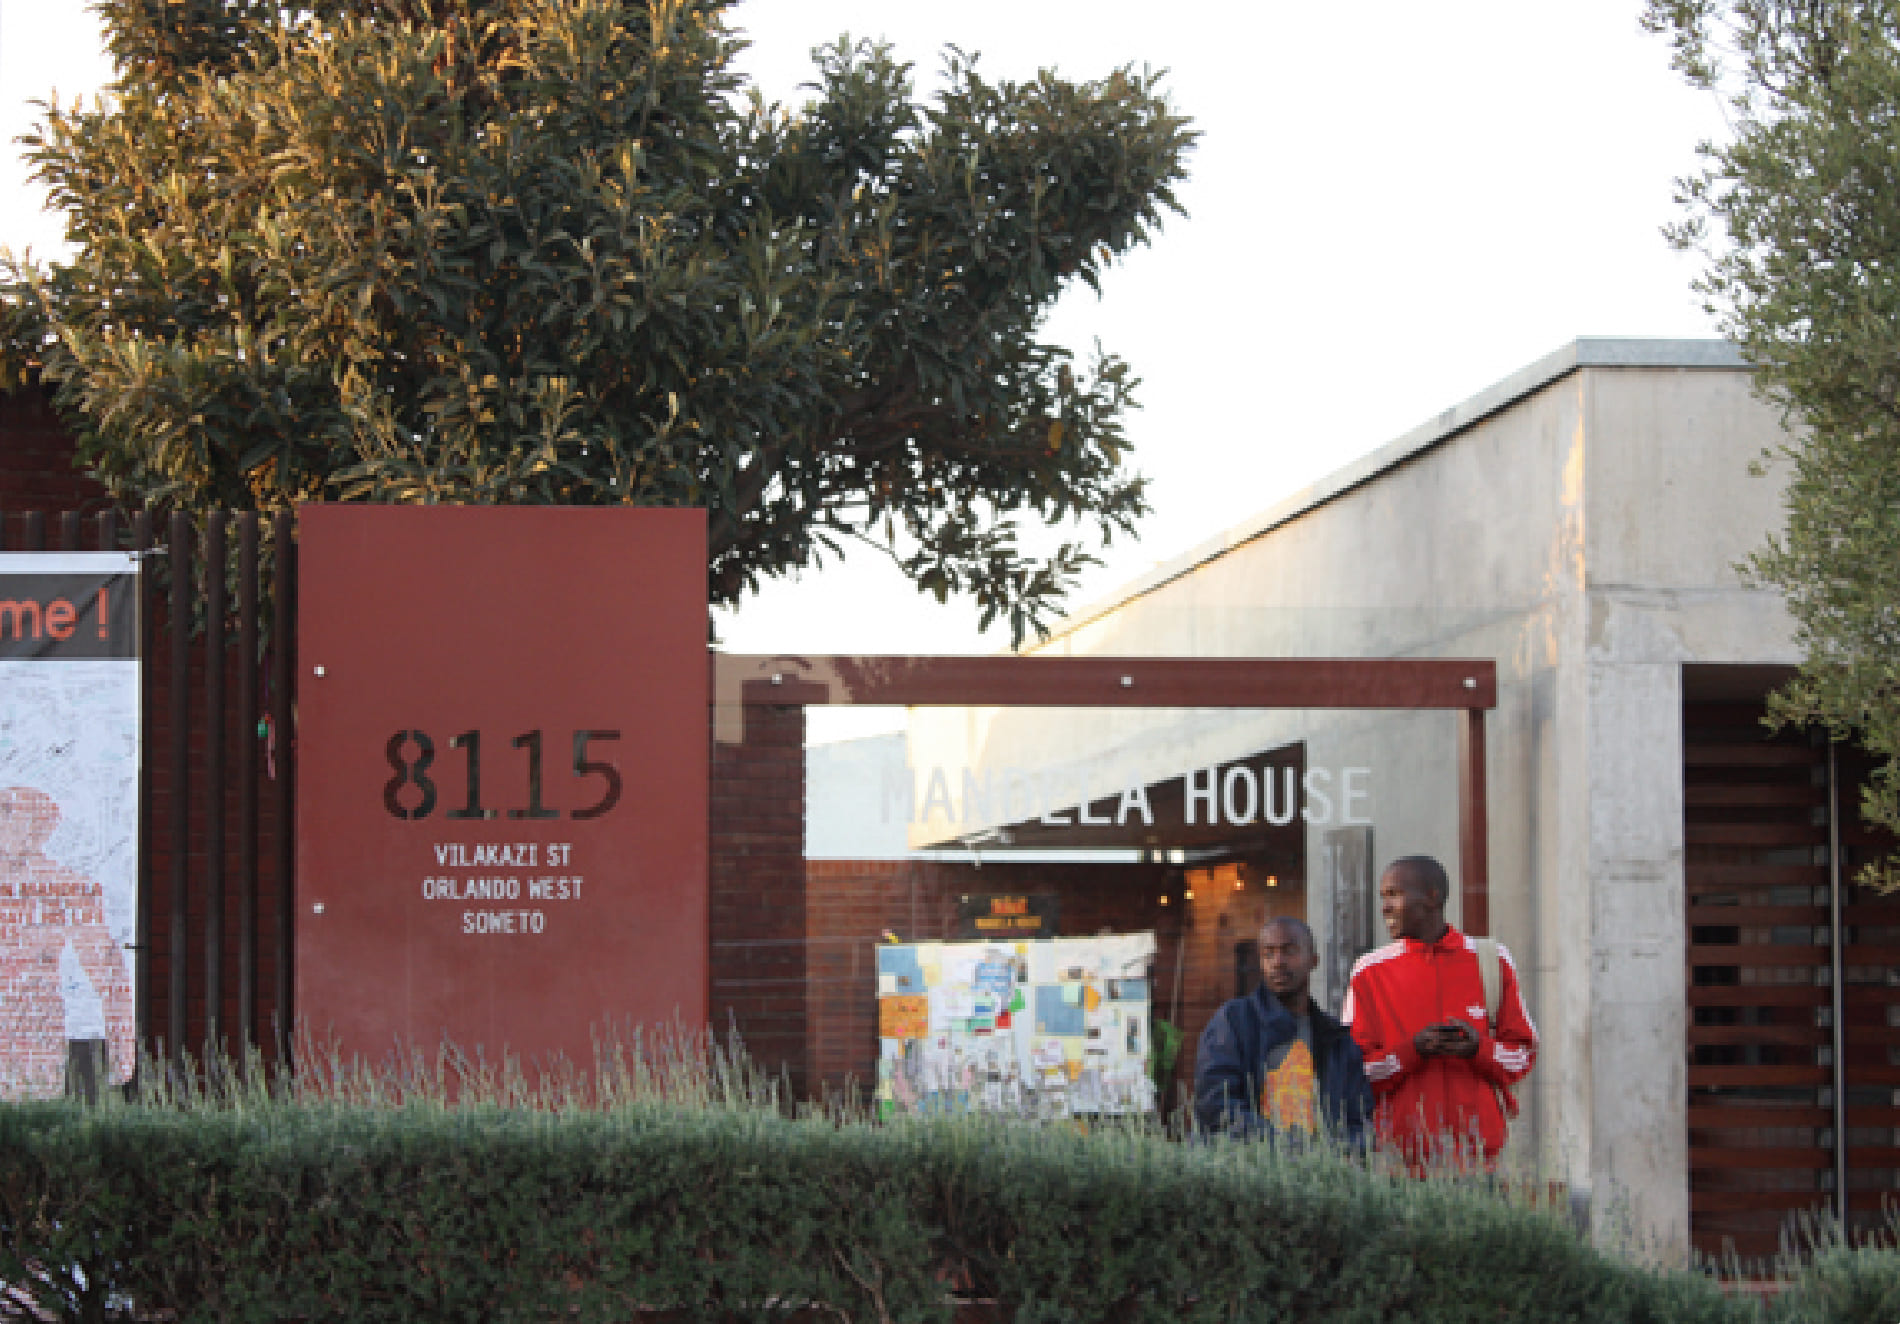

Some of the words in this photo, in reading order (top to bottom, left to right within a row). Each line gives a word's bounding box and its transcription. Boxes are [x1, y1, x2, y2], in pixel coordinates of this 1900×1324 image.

[383, 729, 623, 820] 8115
[1186, 767, 1372, 825] HOUSE
[434, 843, 538, 866] VILAKAZI
[547, 843, 571, 866] ST
[422, 876, 520, 899] ORLANDO
[528, 876, 584, 899] WEST
